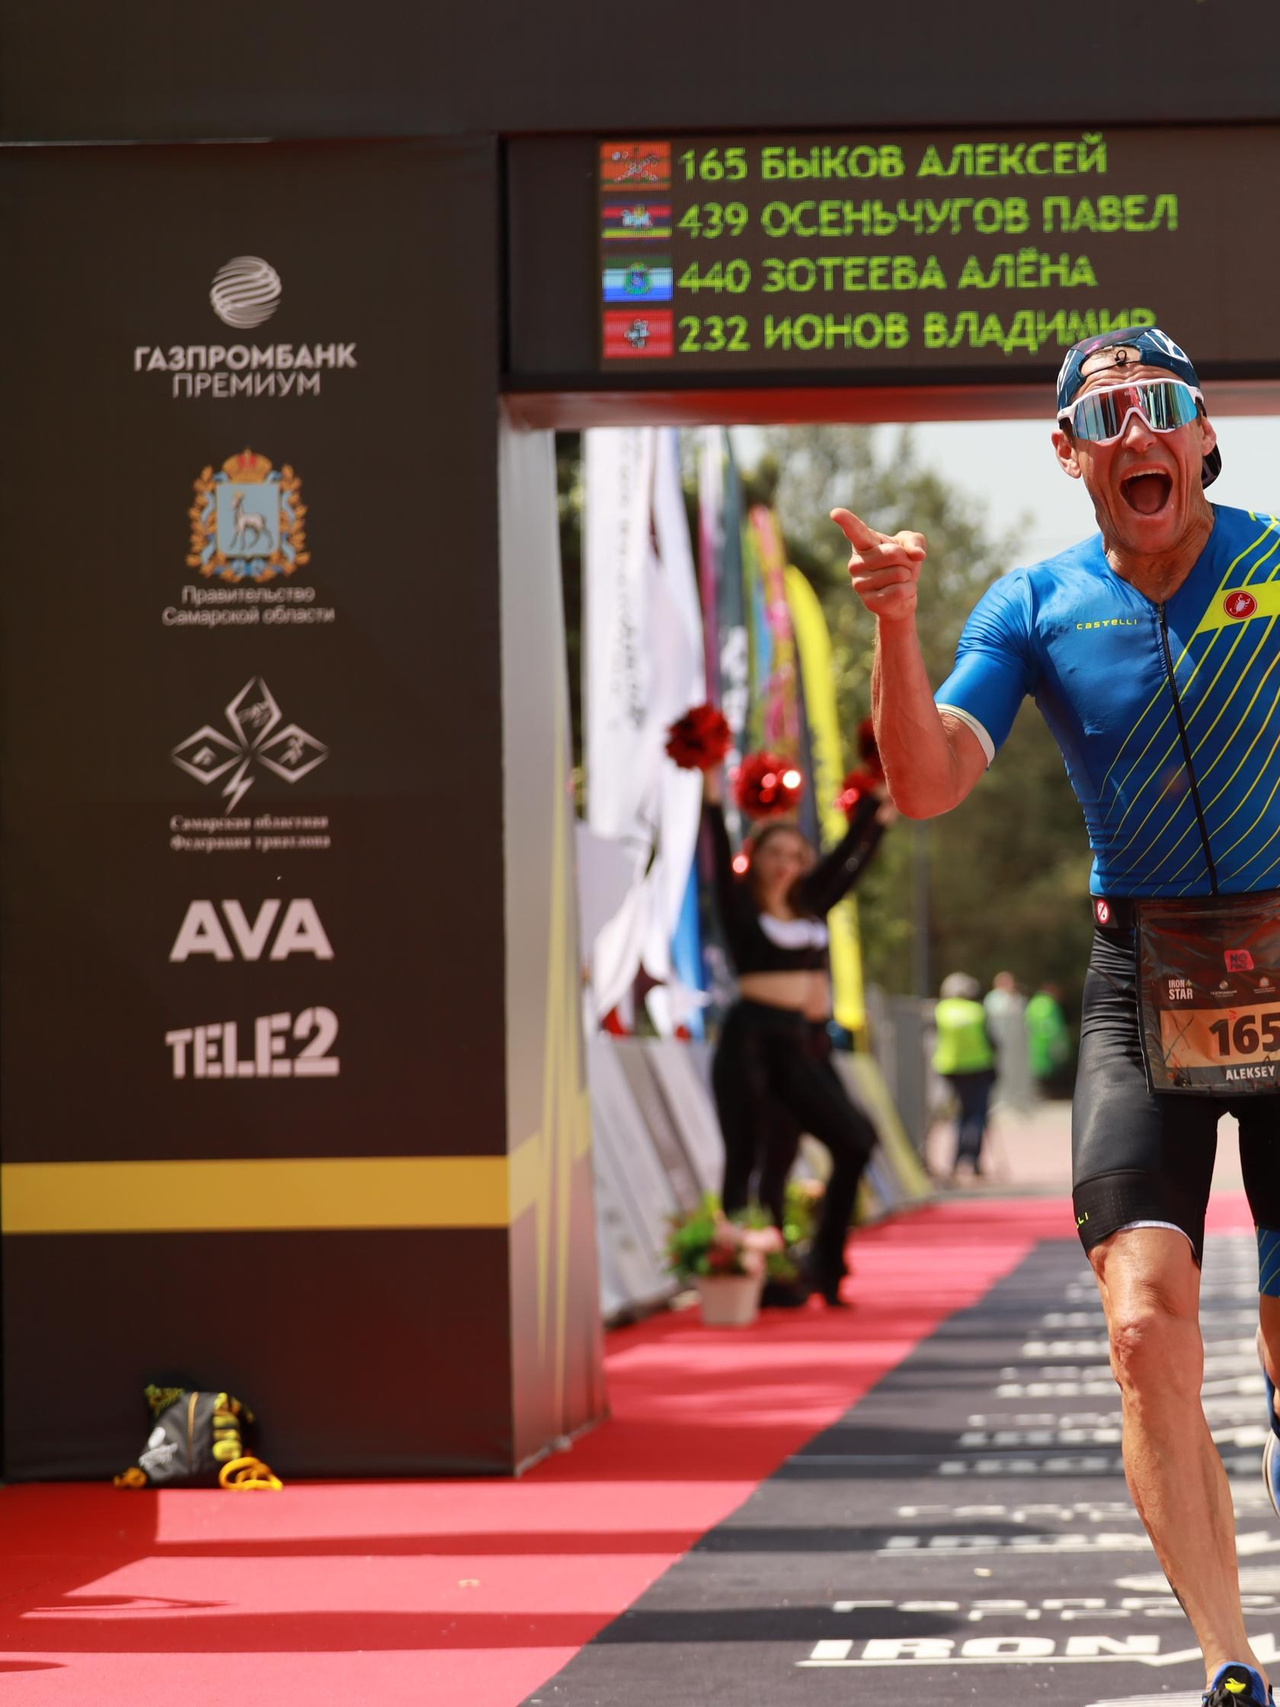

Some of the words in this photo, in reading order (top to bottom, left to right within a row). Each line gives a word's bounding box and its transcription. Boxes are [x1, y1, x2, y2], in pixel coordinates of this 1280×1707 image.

[679, 147, 748, 182] 165
[761, 144, 907, 181] БЫКОВ
[917, 133, 1108, 178] АЛЕКСЕЙ
[678, 202, 750, 239] 439
[760, 198, 1030, 238] ОСЕНЬЧУГОВ
[1043, 193, 1179, 234] ПАВЕЛ
[678, 258, 752, 294] 440
[761, 255, 947, 293] ЗОТЕЕВА
[958, 248, 1099, 290] АЛЁНА
[678, 315, 751, 353] 232
[763, 312, 910, 352] ИОНОВ
[133, 343, 358, 371] ГАЗПРОМБАНК
[172, 371, 321, 399] ПРЕМИУМ
[181, 585, 316, 607] Правительство
[168, 898, 335, 963] AVA
[1168, 979, 1185, 989] IRON
[1168, 988, 1193, 1000] STAR
[165, 1006, 340, 1079] TELE2
[1225, 1065, 1275, 1081] ALEKSEY
[809, 1635, 1161, 1659] IRON
